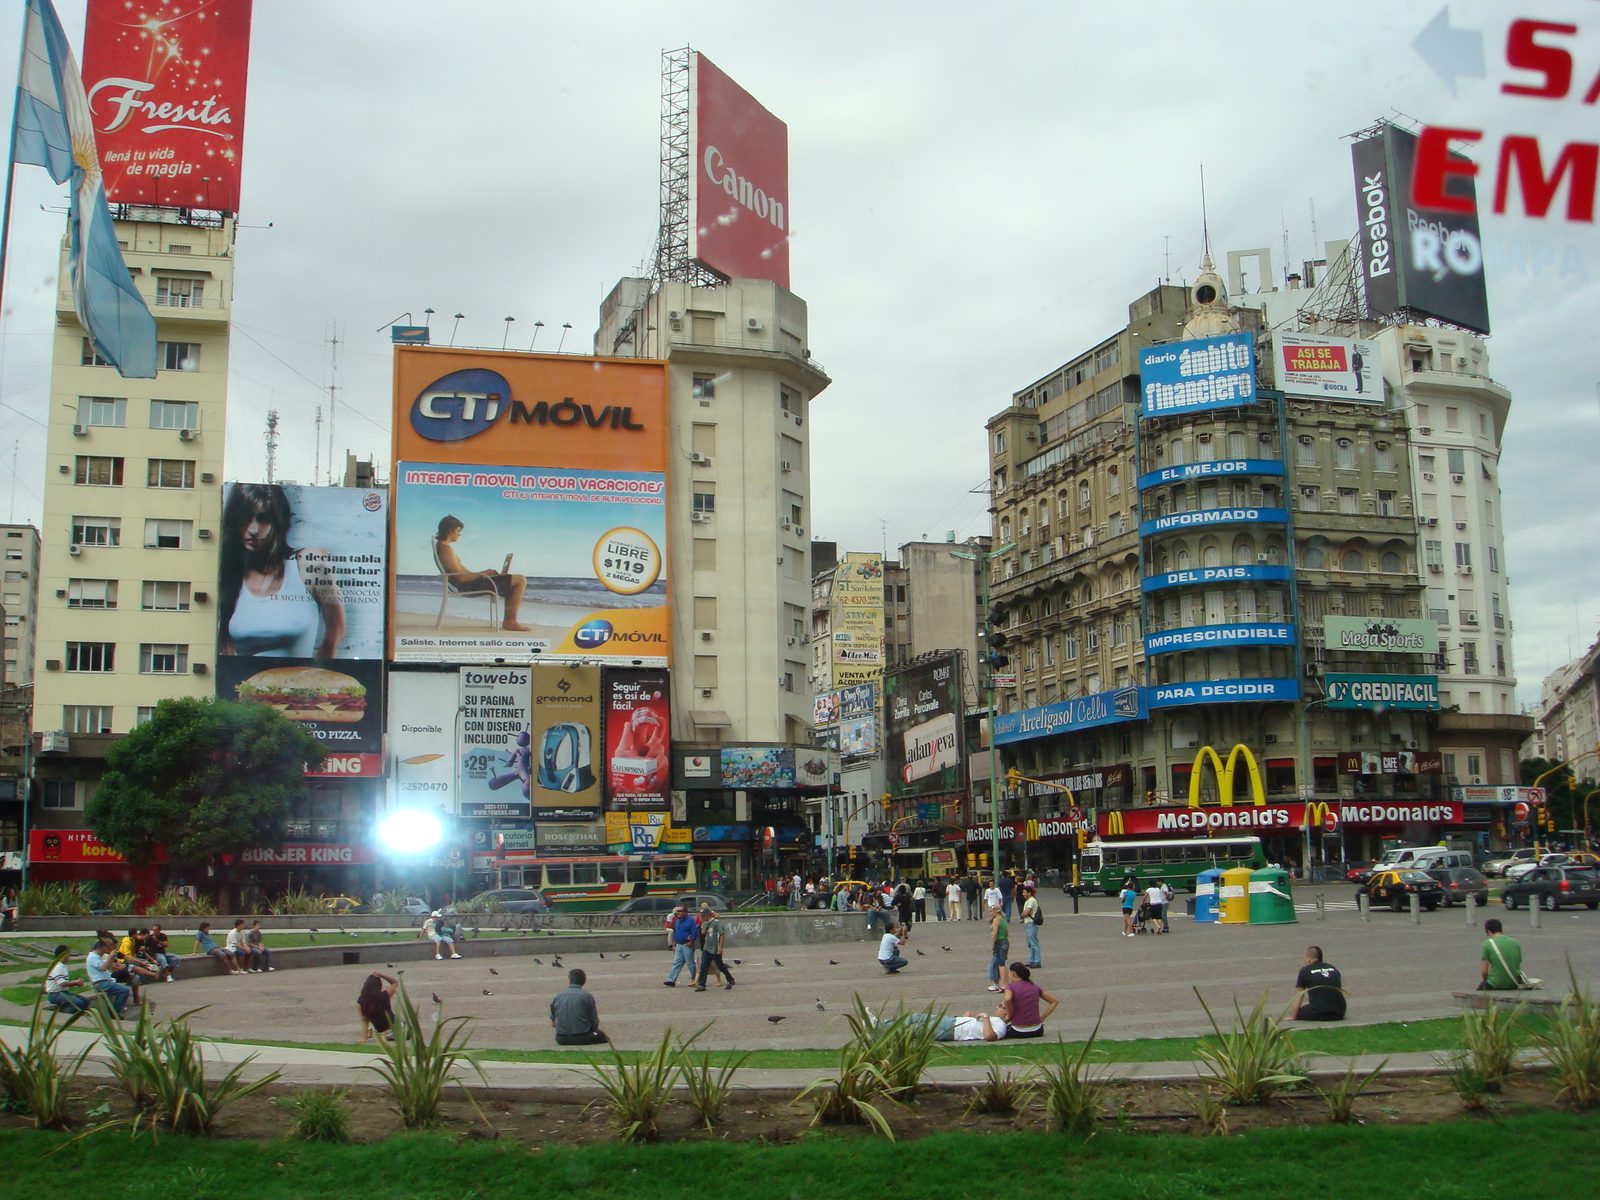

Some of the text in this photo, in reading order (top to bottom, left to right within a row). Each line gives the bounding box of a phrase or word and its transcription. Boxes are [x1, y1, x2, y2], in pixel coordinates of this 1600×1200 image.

[1500, 18, 1600, 105] S
[88, 77, 232, 132] Fresita
[104, 148, 175, 162] llená tu vida
[126, 162, 192, 178] de magia
[704, 145, 784, 232] Canon
[1362, 171, 1391, 278] Reebok
[1145, 341, 1250, 378] diario ámbito
[1298, 348, 1332, 359] ASI SE
[1291, 359, 1341, 370] TRABAJA
[1145, 372, 1252, 412] financiero
[509, 397, 645, 432] MÓVIL
[1161, 461, 1248, 480] EL MEJOR
[407, 470, 664, 494] INTERNET MOVIL IN YOUR VACACIONES
[530, 492, 565, 501] INTERNET
[1156, 510, 1259, 530] INFORMADO
[349, 554, 381, 564] tabla
[608, 543, 649, 562] LIBRE
[306, 564, 381, 576] de planchar
[604, 558, 645, 574] $119
[304, 577, 381, 588] a los quince.
[612, 573, 641, 585] MEGAS
[1168, 567, 1251, 585] DEL PAIS.
[400, 637, 548, 648] Saliste. Internet salió con vos.
[611, 630, 668, 644] MÓVIL
[1148, 628, 1288, 650] IMPRESCINDIBLE
[465, 670, 528, 685] towebs
[839, 671, 865, 679] VENTA
[613, 682, 641, 694] Seguir
[613, 690, 651, 700] es así de
[1157, 683, 1275, 701] PARA DECIDIR
[1351, 682, 1439, 703] CREDIFACIL
[464, 695, 515, 706] SU PAGINA
[535, 694, 593, 705] gremond
[613, 700, 634, 711] fácil.
[464, 708, 526, 719] EN INTERNET
[1019, 706, 1073, 734] Arceligasol
[401, 724, 443, 734] Disponible
[464, 719, 522, 732] CON DISEÑO
[328, 730, 362, 740] PIZZA.
[464, 733, 508, 744] INCLUIDO
[1157, 809, 1289, 830] McDonald's
[1341, 804, 1453, 823] McDonald's
[632, 826, 657, 850] Rp.
[310, 848, 353, 862] KING
